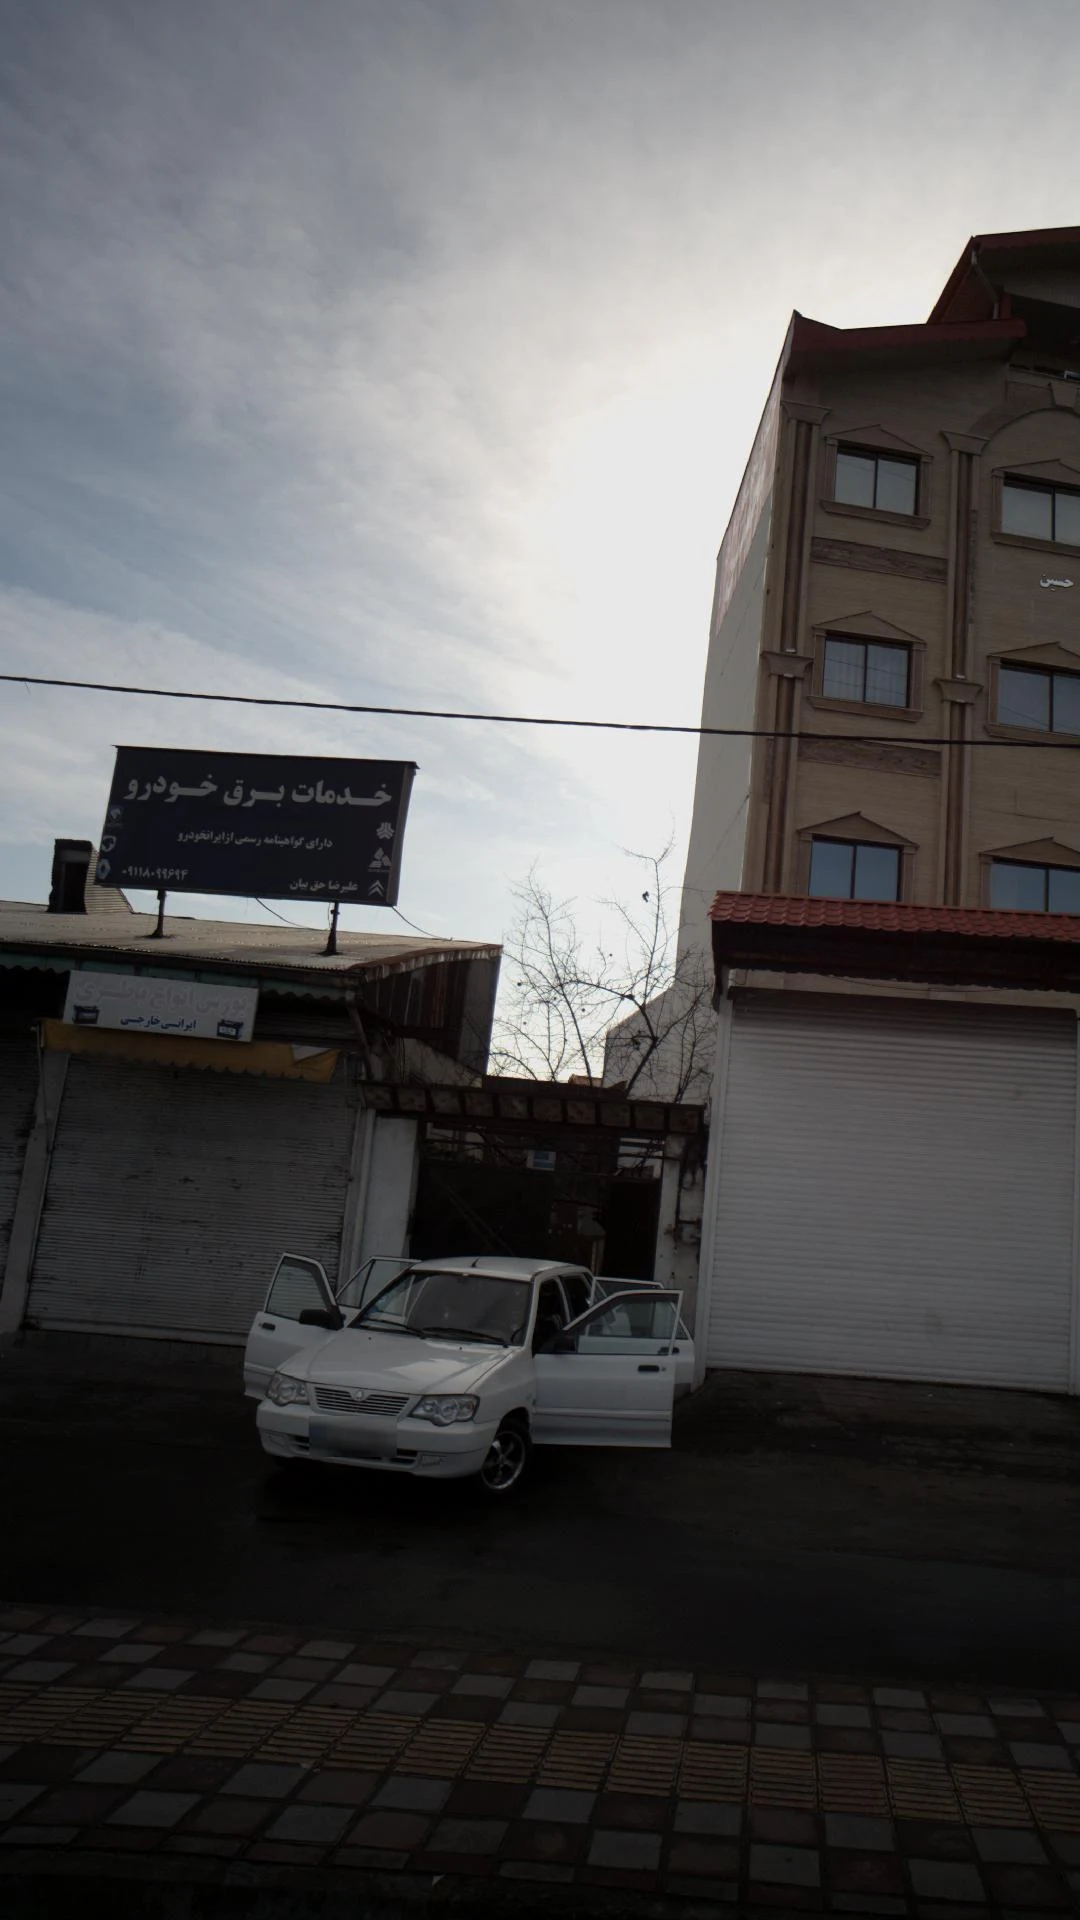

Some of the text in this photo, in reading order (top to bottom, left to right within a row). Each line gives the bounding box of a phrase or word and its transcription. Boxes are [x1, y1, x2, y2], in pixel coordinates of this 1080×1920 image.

[1040, 574, 1074, 592] حسین
[123, 774, 392, 808] خدمات برق خودرو
[305, 837, 333, 851] دارای
[328, 879, 359, 894] علیرضا
[160, 1016, 197, 1032] ایرانی
